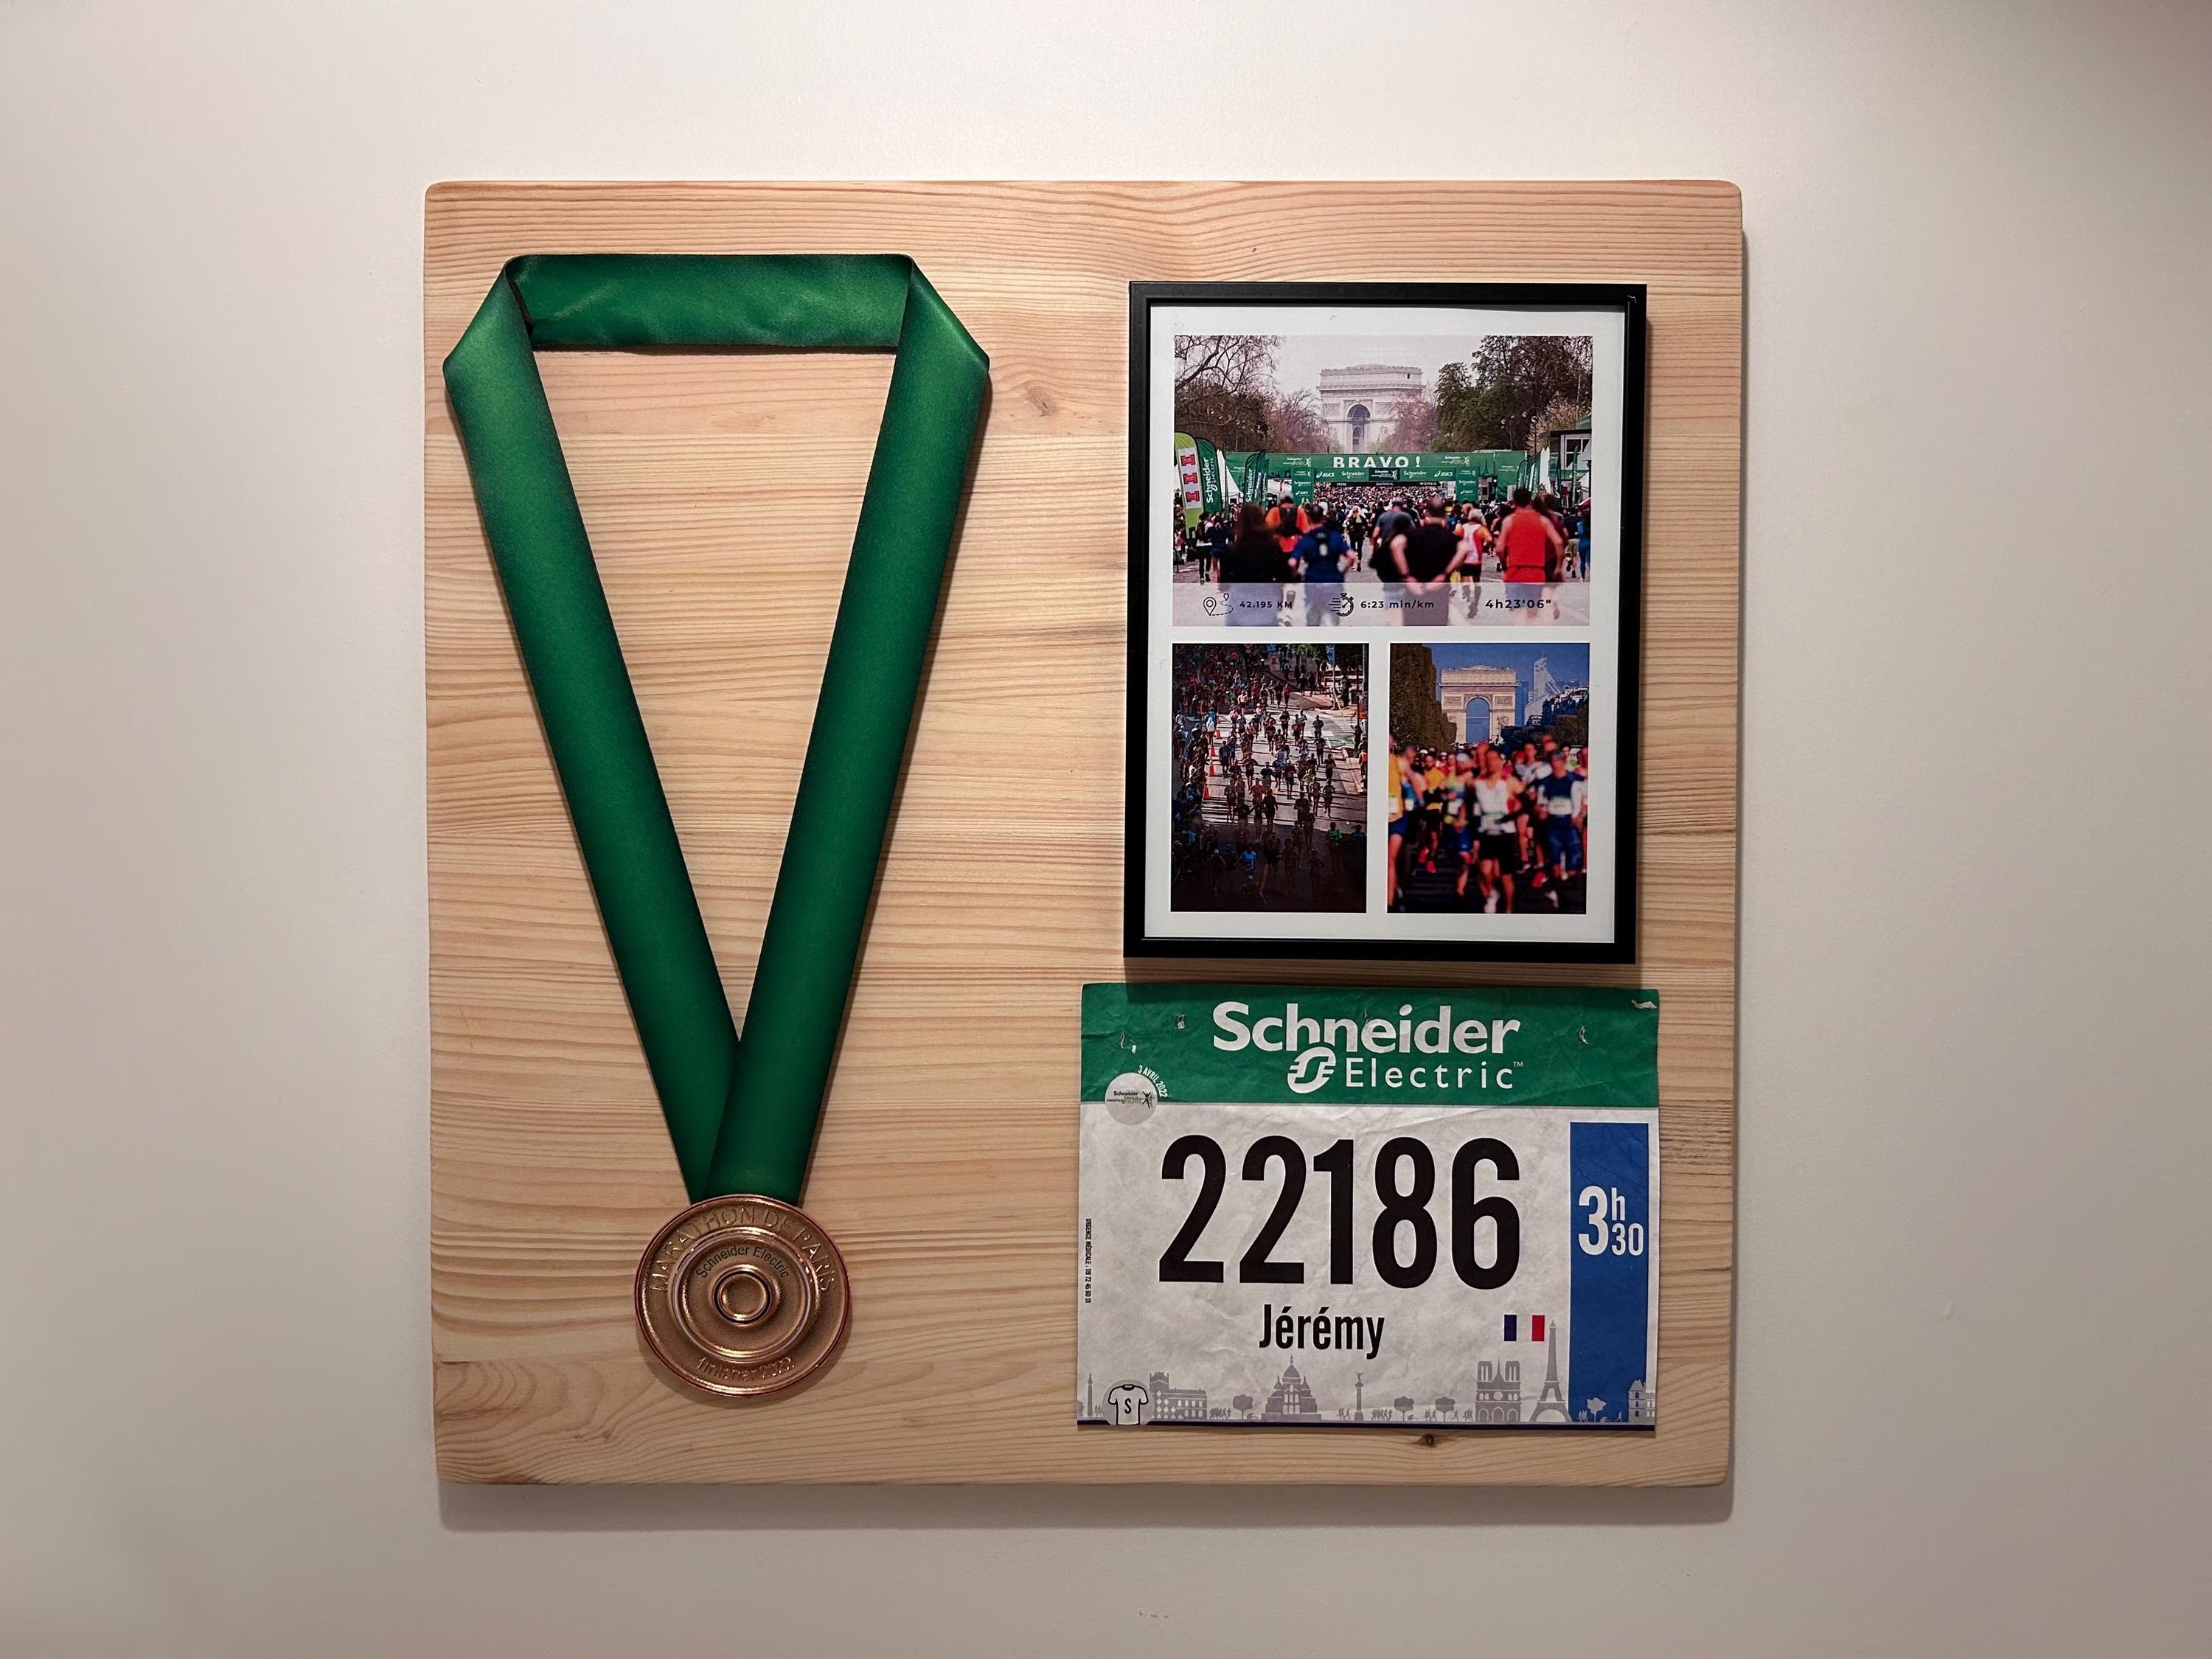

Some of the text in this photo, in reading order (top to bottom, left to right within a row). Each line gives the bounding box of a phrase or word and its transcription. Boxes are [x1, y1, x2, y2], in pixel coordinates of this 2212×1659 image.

[1333, 456, 1409, 467] BRAVO
[1203, 457, 1214, 503] Schneider
[1239, 600, 1293, 609] 42.195 KM
[1360, 599, 1435, 609] 6:23 min/km
[1212, 1001, 1521, 1054] Schneider
[1138, 1065, 1169, 1098] 3 AVRIL 2022
[1346, 1057, 1513, 1089] Electric
[1158, 1134, 1520, 1290] 22186
[696, 1245, 790, 1279] Schneider Electric
[1259, 1304, 1385, 1360] Jérémy
[1124, 1397, 1132, 1414] S
